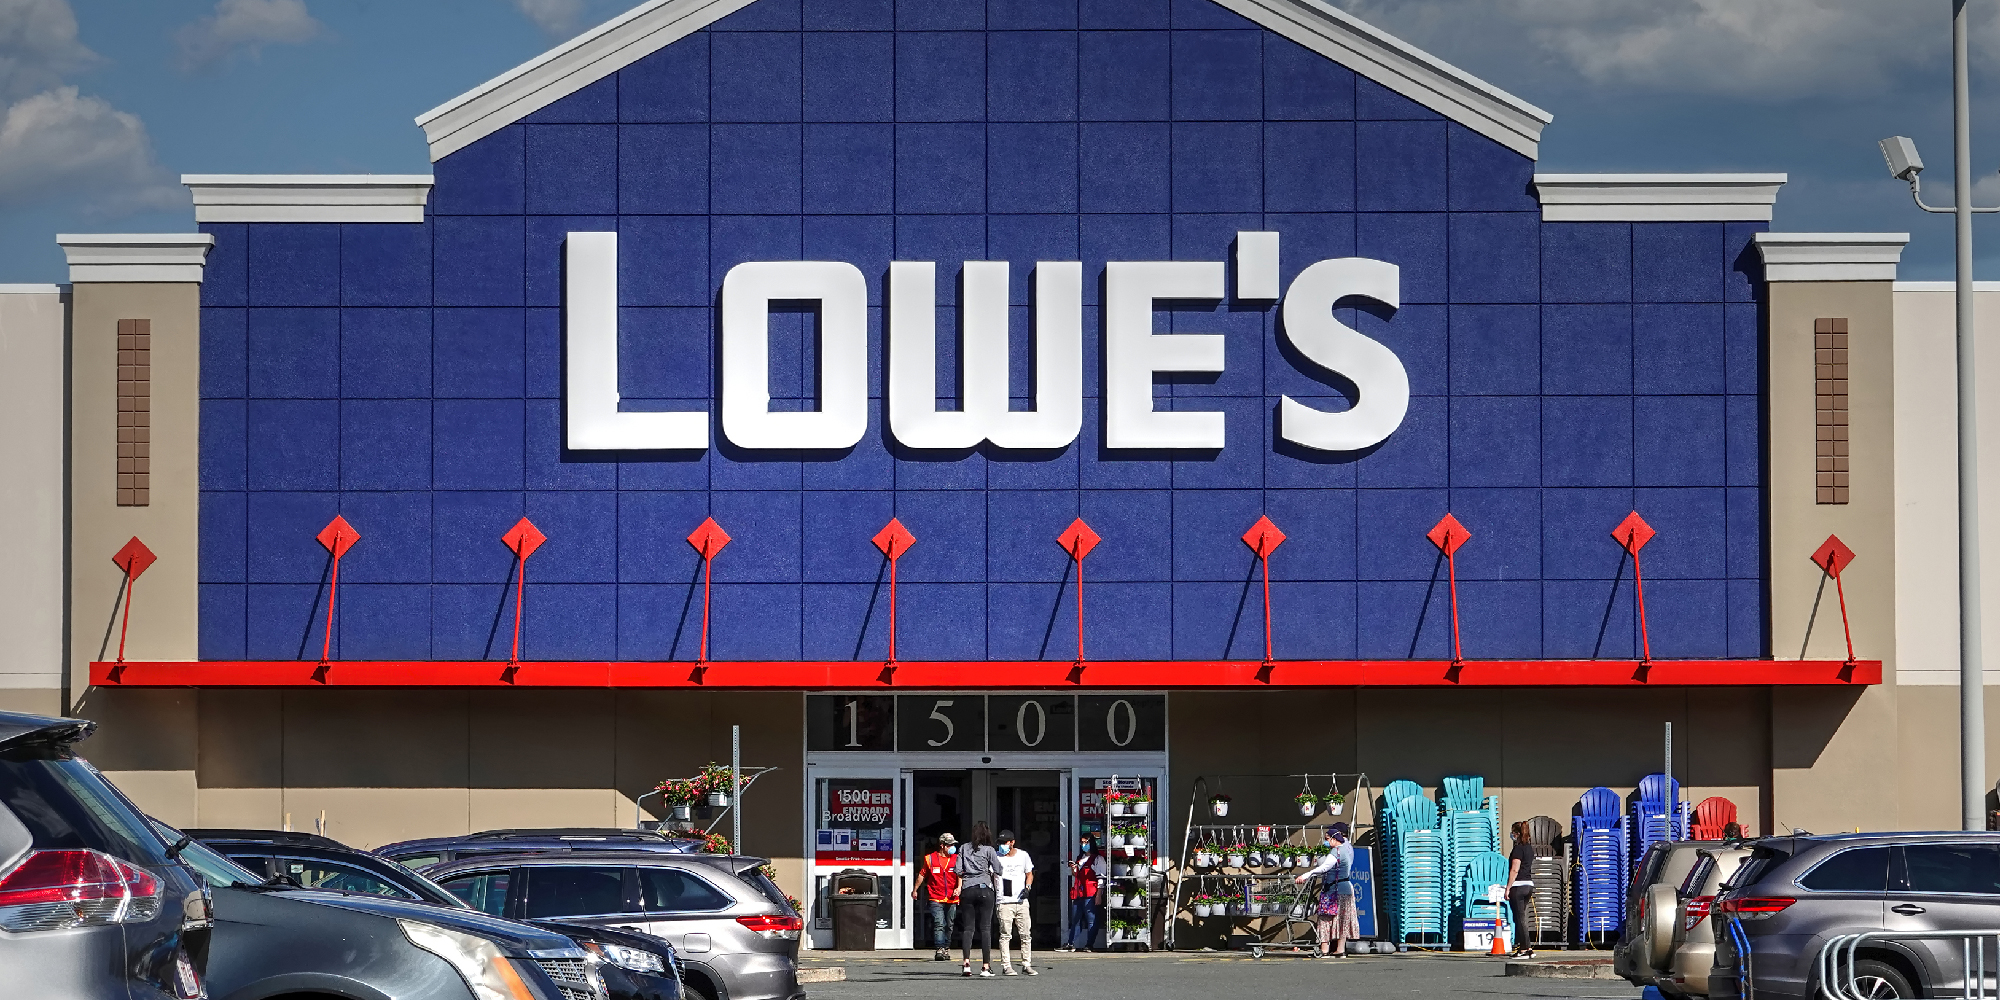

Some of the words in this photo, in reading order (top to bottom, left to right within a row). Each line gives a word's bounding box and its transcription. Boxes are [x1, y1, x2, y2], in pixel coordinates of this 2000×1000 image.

[566, 231, 1410, 452] LOWE'S
[837, 789, 870, 803] 1500
[822, 810, 887, 824] Broadway
[842, 806, 890, 815] ENTRADA
[1349, 866, 1370, 883] ickup
